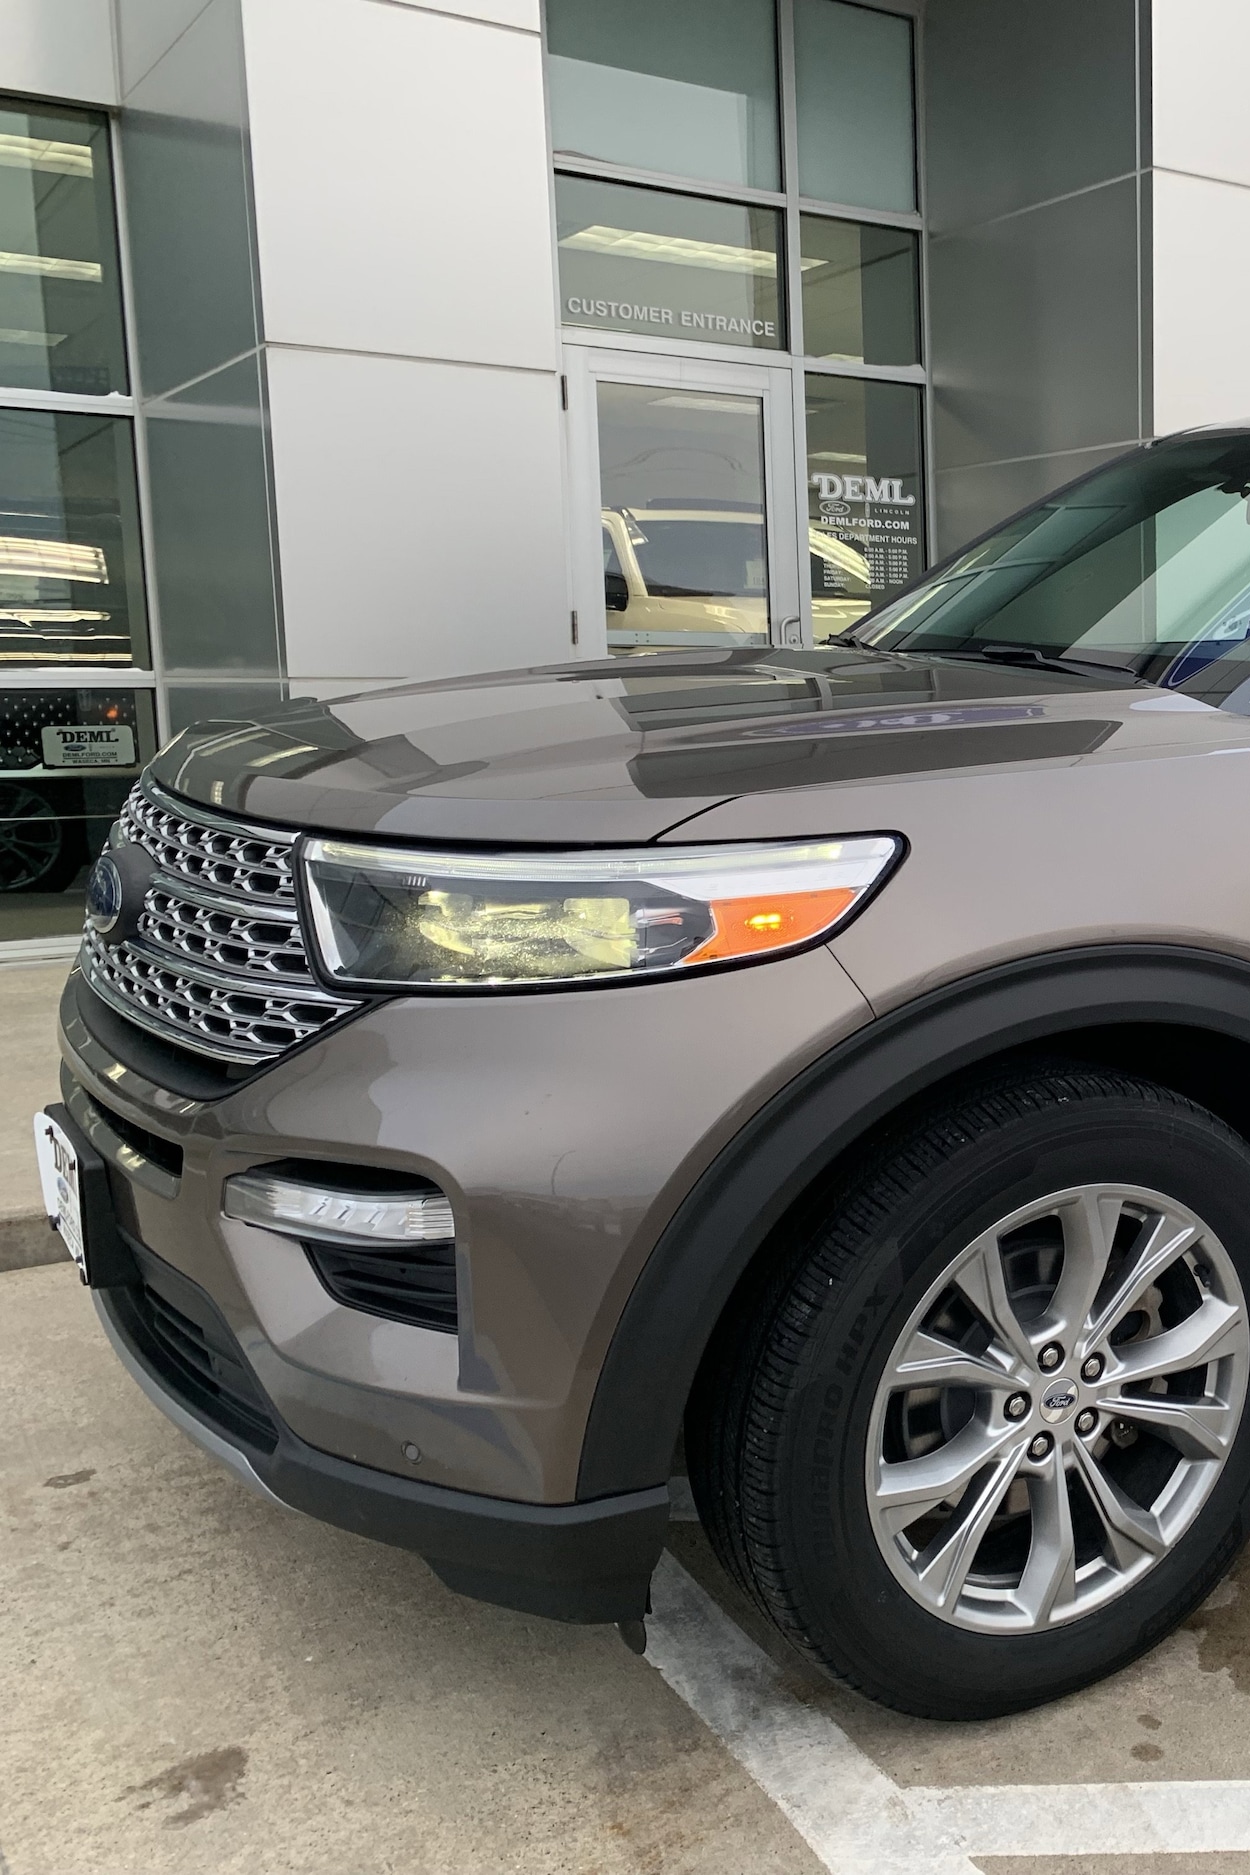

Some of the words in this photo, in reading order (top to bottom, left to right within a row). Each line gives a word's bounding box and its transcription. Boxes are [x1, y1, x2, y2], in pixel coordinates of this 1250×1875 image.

[567, 296, 673, 325] CUSTOMER
[681, 311, 776, 337] ENTRANCE
[811, 472, 916, 506] DEML
[874, 507, 911, 515] LINCOLN
[821, 516, 910, 530] DEMLFORD.COM
[838, 533, 890, 543] DEPARTMENT
[891, 535, 918, 545] HOURS
[56, 730, 119, 743] DEML
